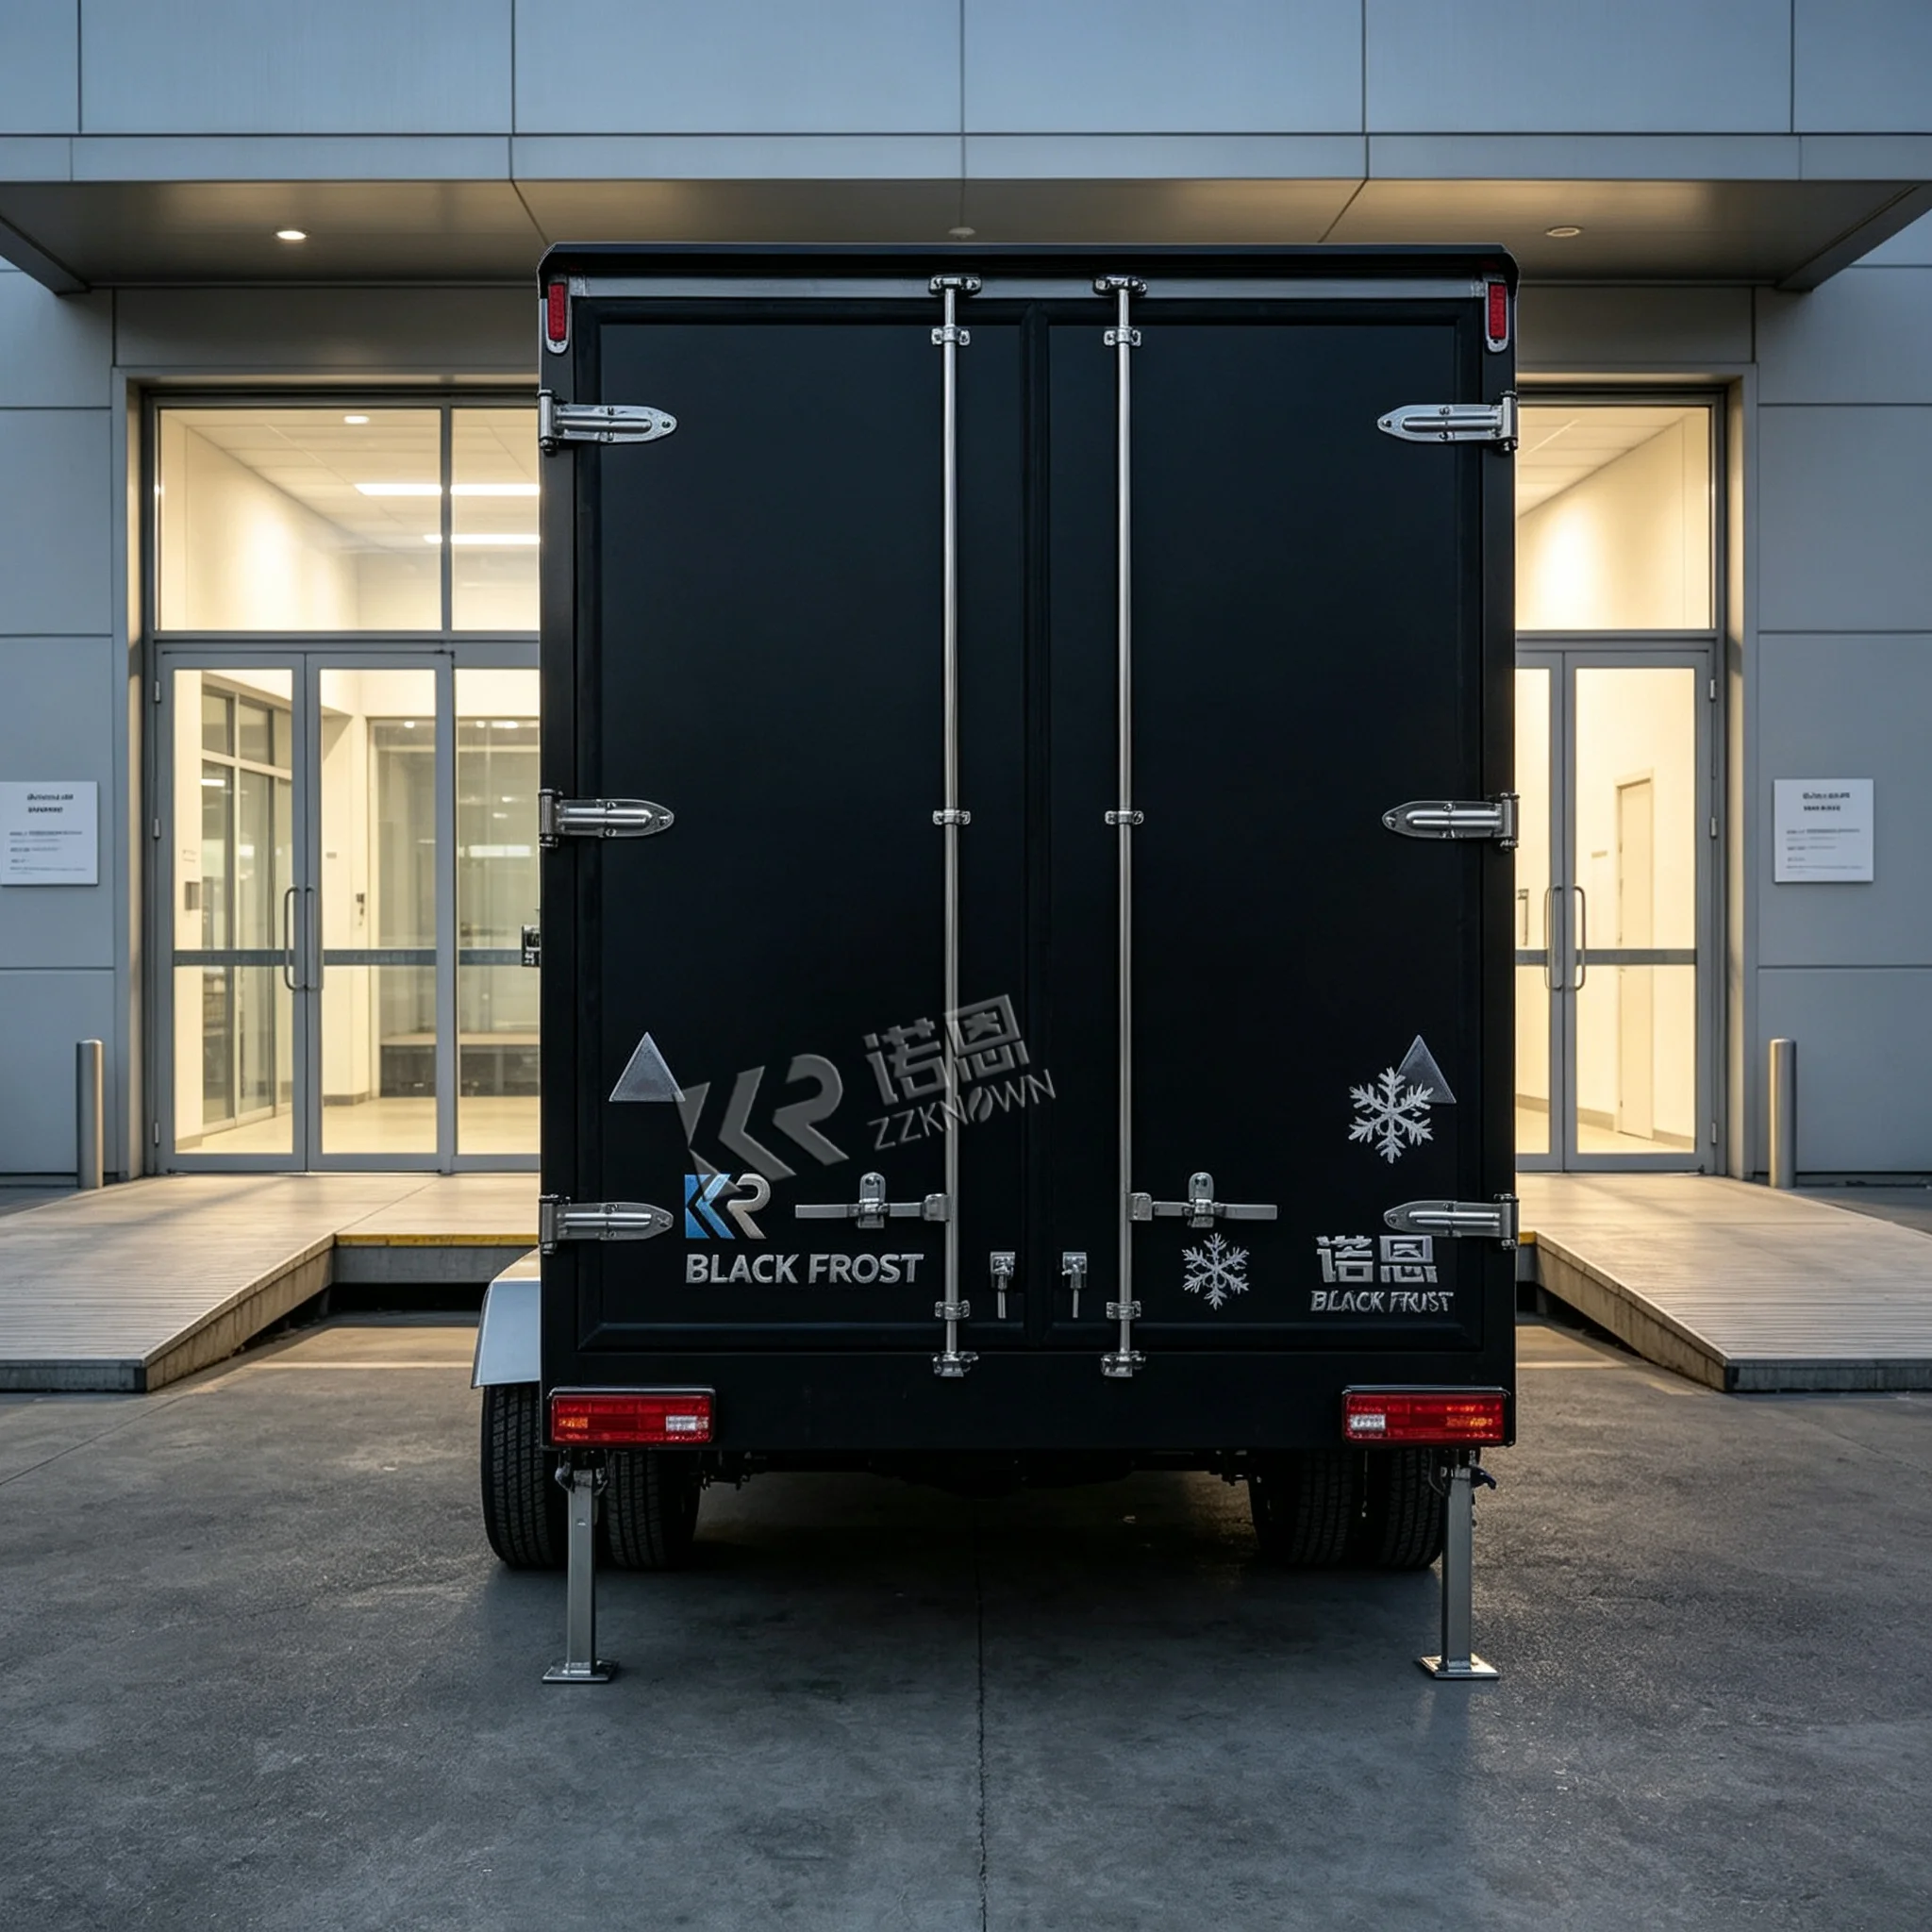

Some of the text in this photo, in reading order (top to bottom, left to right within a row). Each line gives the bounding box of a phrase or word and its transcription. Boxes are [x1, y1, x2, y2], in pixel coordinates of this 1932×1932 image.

[685, 1253, 924, 1284] BLACK FROST
[1309, 1290, 1386, 1313] BLACK
